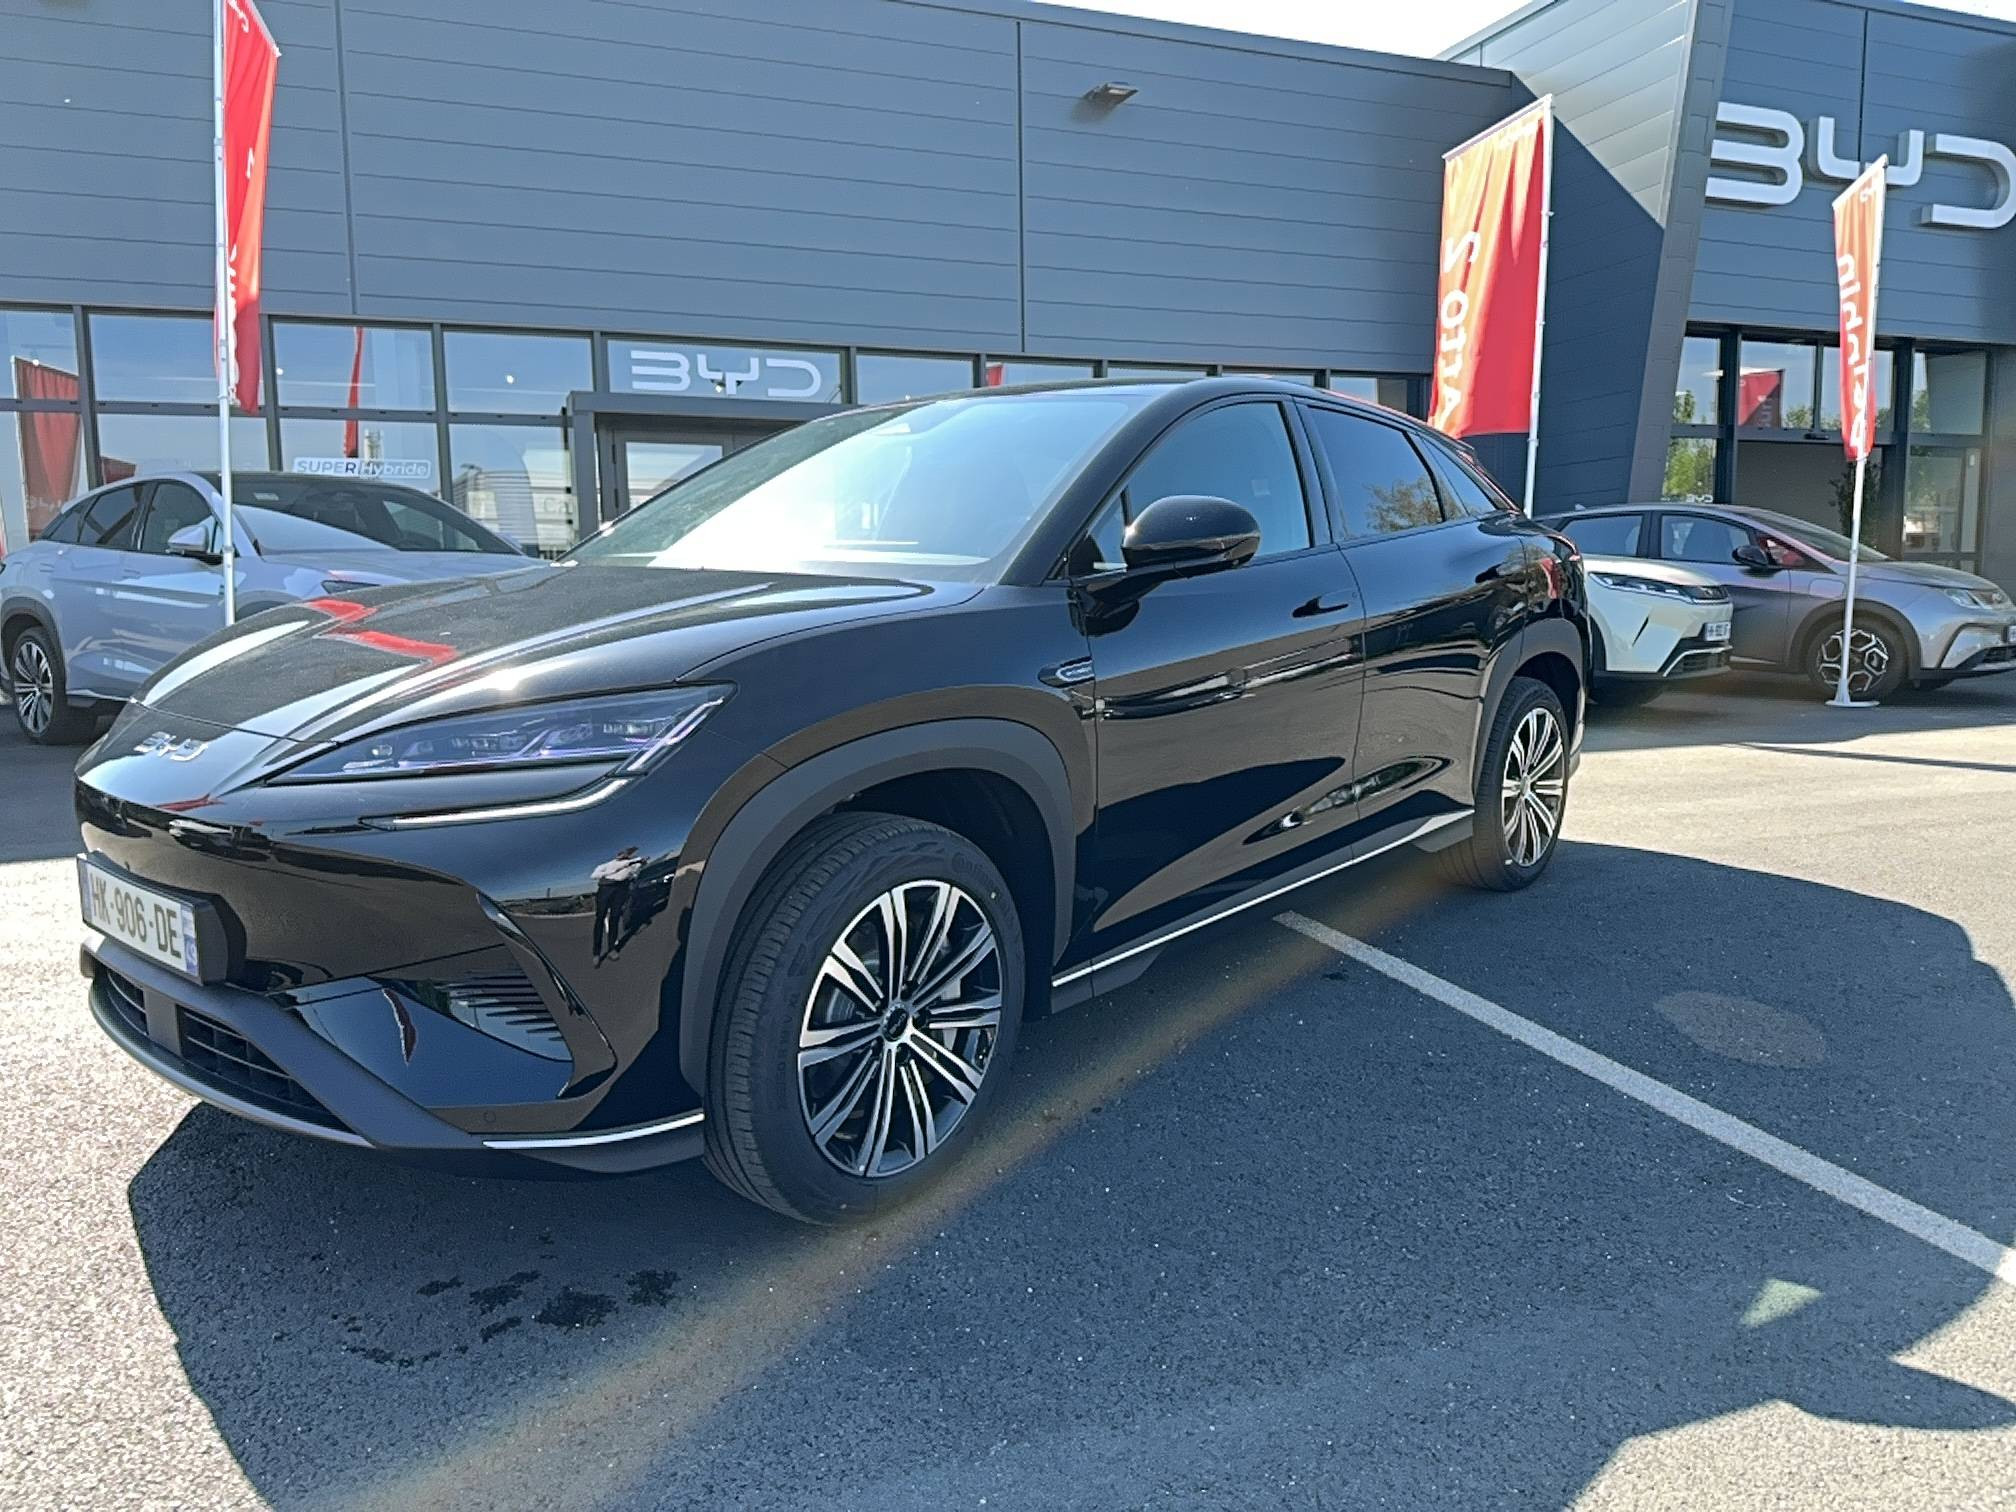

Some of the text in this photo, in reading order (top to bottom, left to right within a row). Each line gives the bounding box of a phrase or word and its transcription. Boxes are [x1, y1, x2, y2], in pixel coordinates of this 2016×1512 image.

[1705, 101, 2016, 229] BYD
[630, 350, 822, 397] BYD
[298, 459, 427, 477] SUPER Hybride
[91, 873, 181, 959] HK-906-DE
